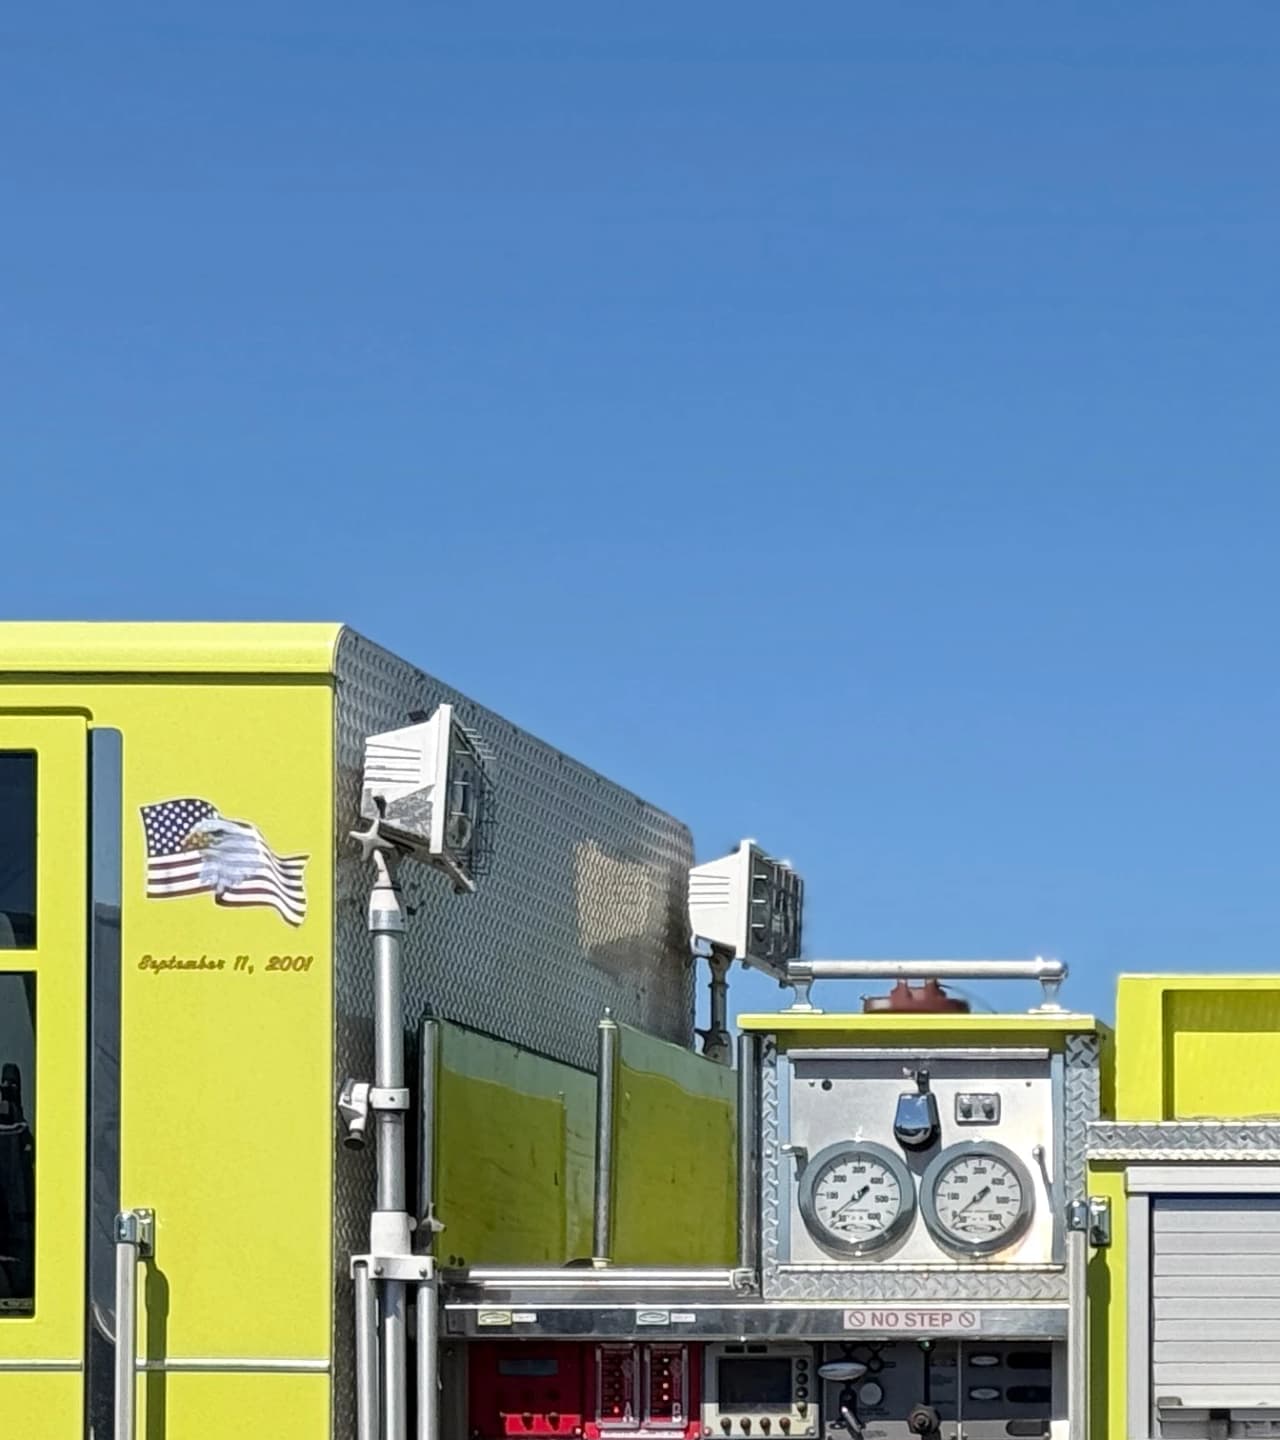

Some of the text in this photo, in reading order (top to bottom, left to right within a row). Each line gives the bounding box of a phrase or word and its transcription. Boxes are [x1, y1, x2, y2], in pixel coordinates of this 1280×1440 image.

[138, 955, 225, 975] September
[265, 956, 313, 972] 2001
[871, 1312, 953, 1328] NO STEP
